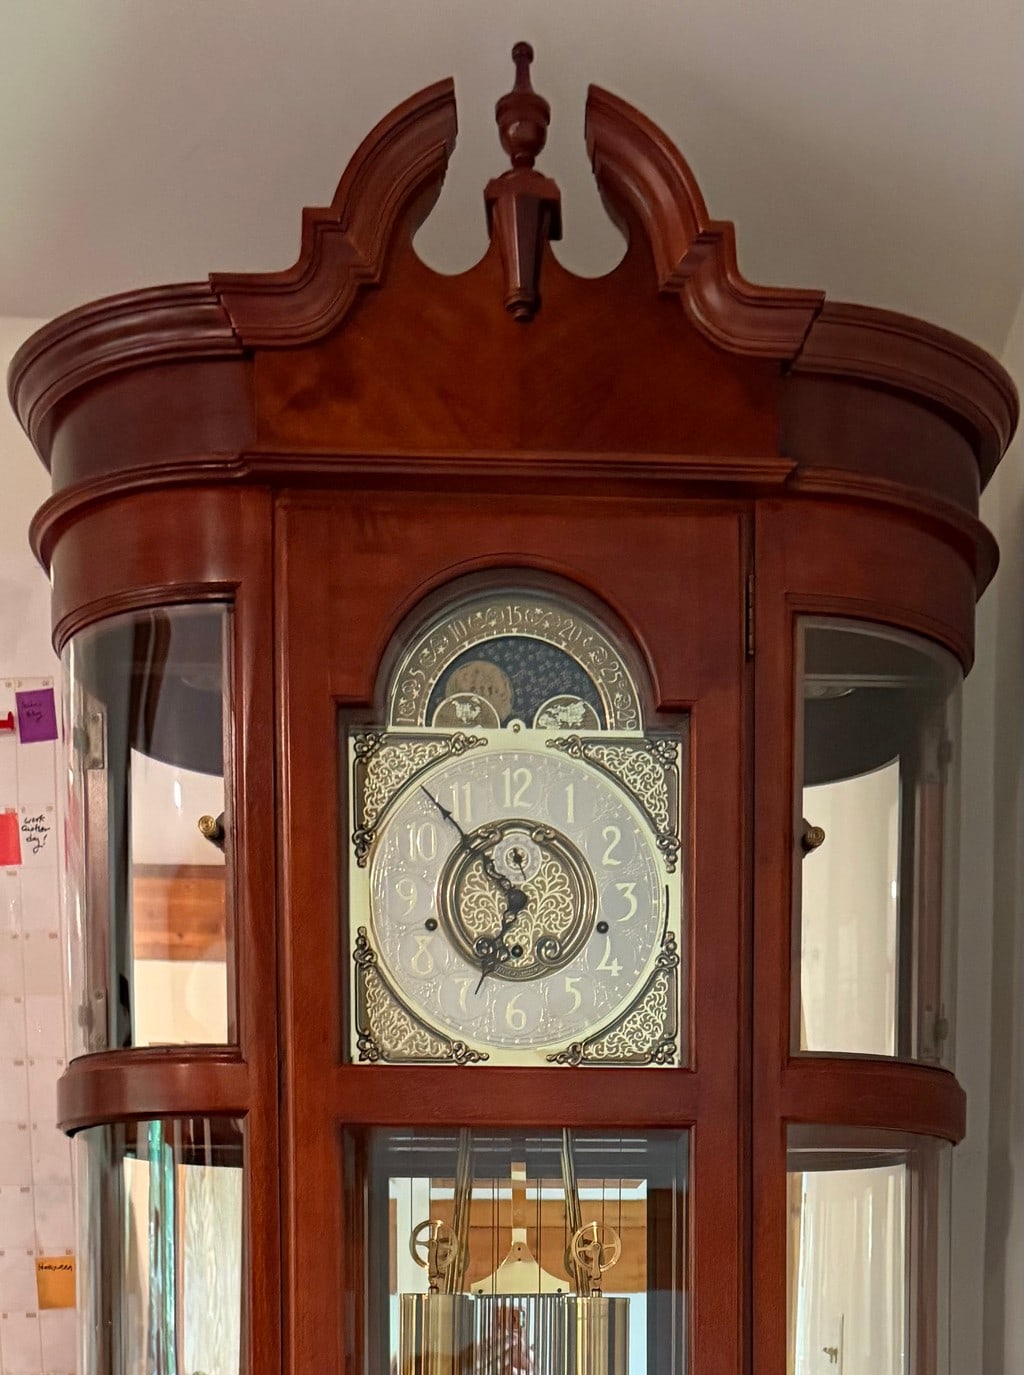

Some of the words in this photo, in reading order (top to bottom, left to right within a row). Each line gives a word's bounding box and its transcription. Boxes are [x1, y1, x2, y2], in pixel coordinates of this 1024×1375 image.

[447, 618, 468, 642] 10
[506, 605, 522, 627] 15
[558, 618, 583, 642] 20
[408, 666, 426, 682] 5
[600, 661, 623, 684] 25
[449, 781, 473, 822] 11
[502, 766, 533, 808] 12
[564, 782, 575, 824] 1
[406, 820, 438, 861] 10
[601, 825, 622, 866] 2
[395, 878, 418, 917] 9
[615, 882, 638, 922] 3
[411, 935, 434, 976] 8
[595, 934, 624, 977] 4
[453, 977, 475, 1013] 7
[505, 992, 528, 1031] 6
[563, 976, 583, 1016] 5
